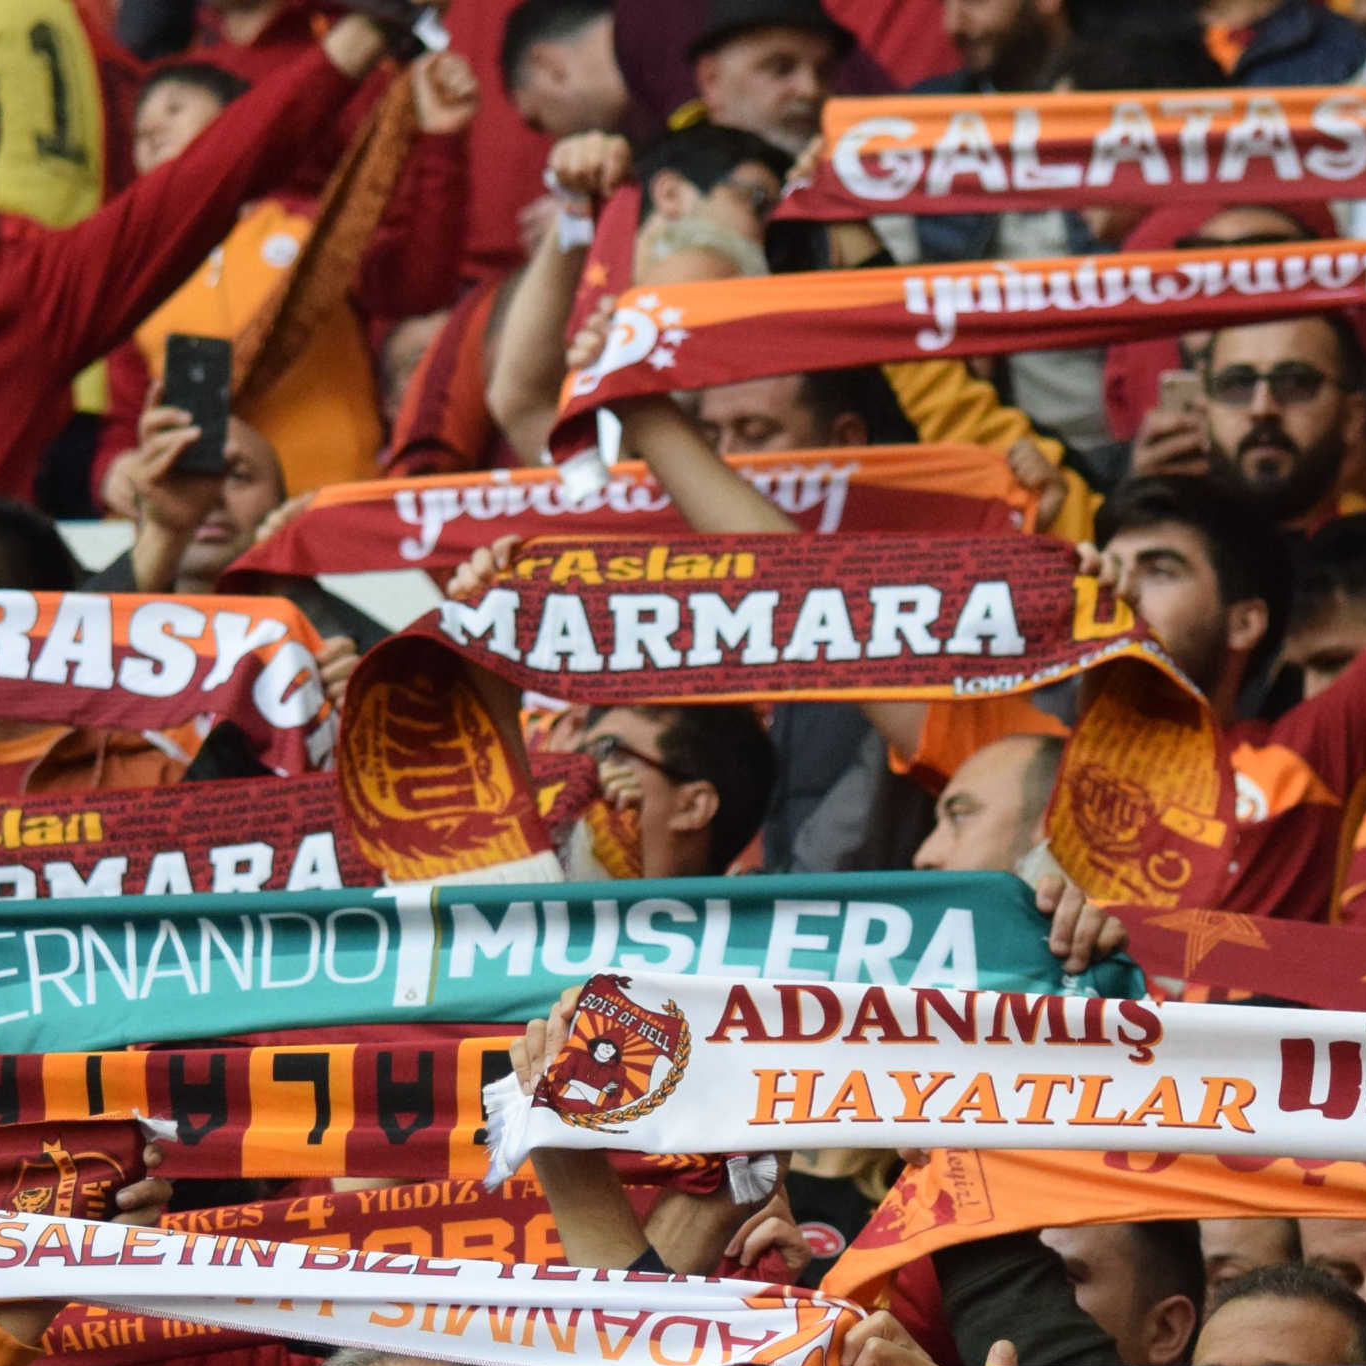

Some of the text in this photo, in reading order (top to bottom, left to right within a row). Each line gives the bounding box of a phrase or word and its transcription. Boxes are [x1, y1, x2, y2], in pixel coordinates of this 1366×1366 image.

[437, 581, 1026, 673] MARMARA
[452, 897, 978, 991] MUSLERA
[618, 1010, 638, 1027] OF
[638, 1021, 671, 1052] HELL
[703, 984, 1166, 1067] ADANMIŞ
[746, 1068, 1257, 1135] HAYATLAR
[159, 1202, 265, 1233] RKES
[285, 1194, 335, 1232] 4
[355, 1179, 480, 1215] YILDIZ
